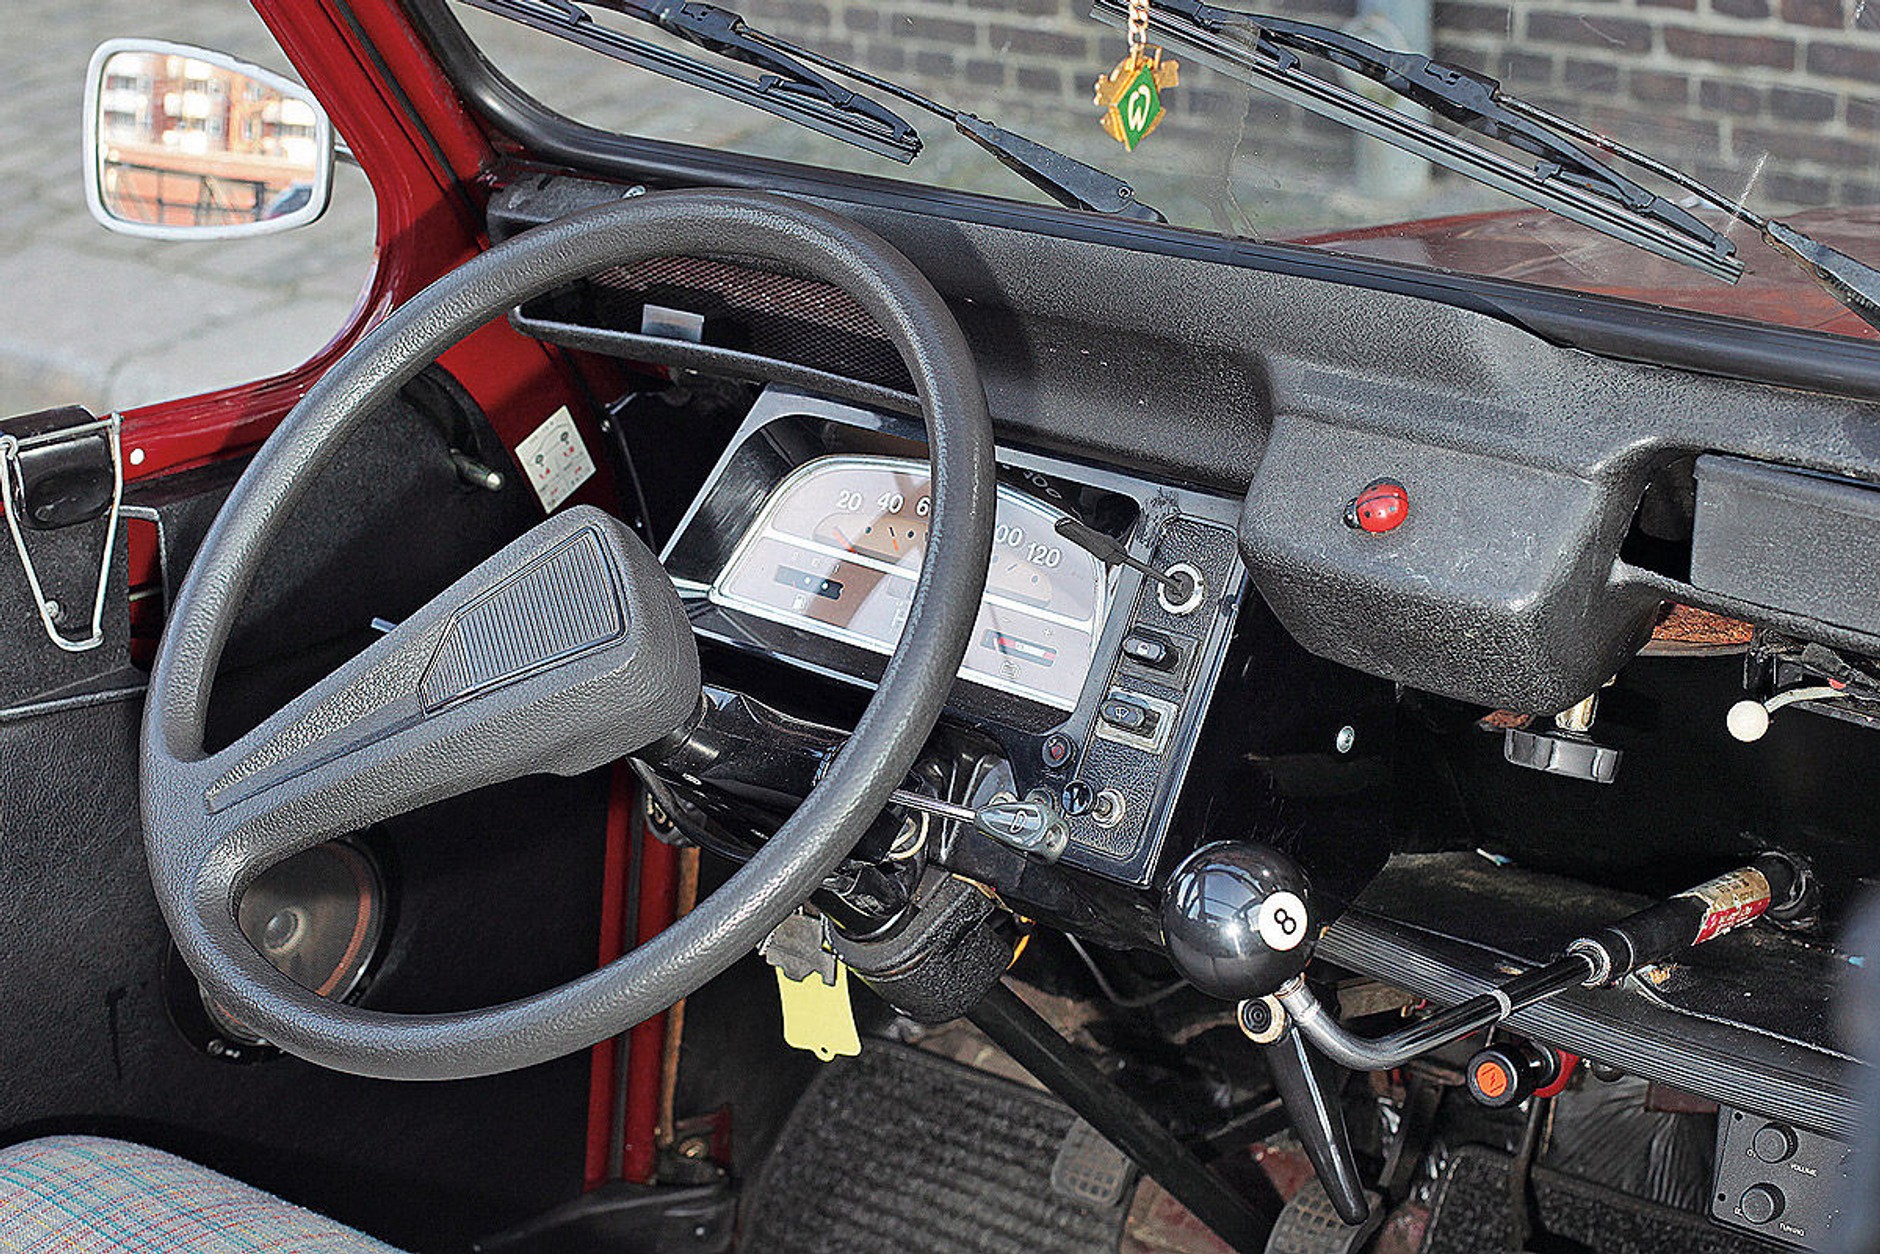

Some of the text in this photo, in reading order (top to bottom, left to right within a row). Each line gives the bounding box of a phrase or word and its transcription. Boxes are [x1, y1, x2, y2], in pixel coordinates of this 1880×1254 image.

[836, 489, 1061, 568] 20 40 6 00 120
[1274, 908, 1297, 936] 8
